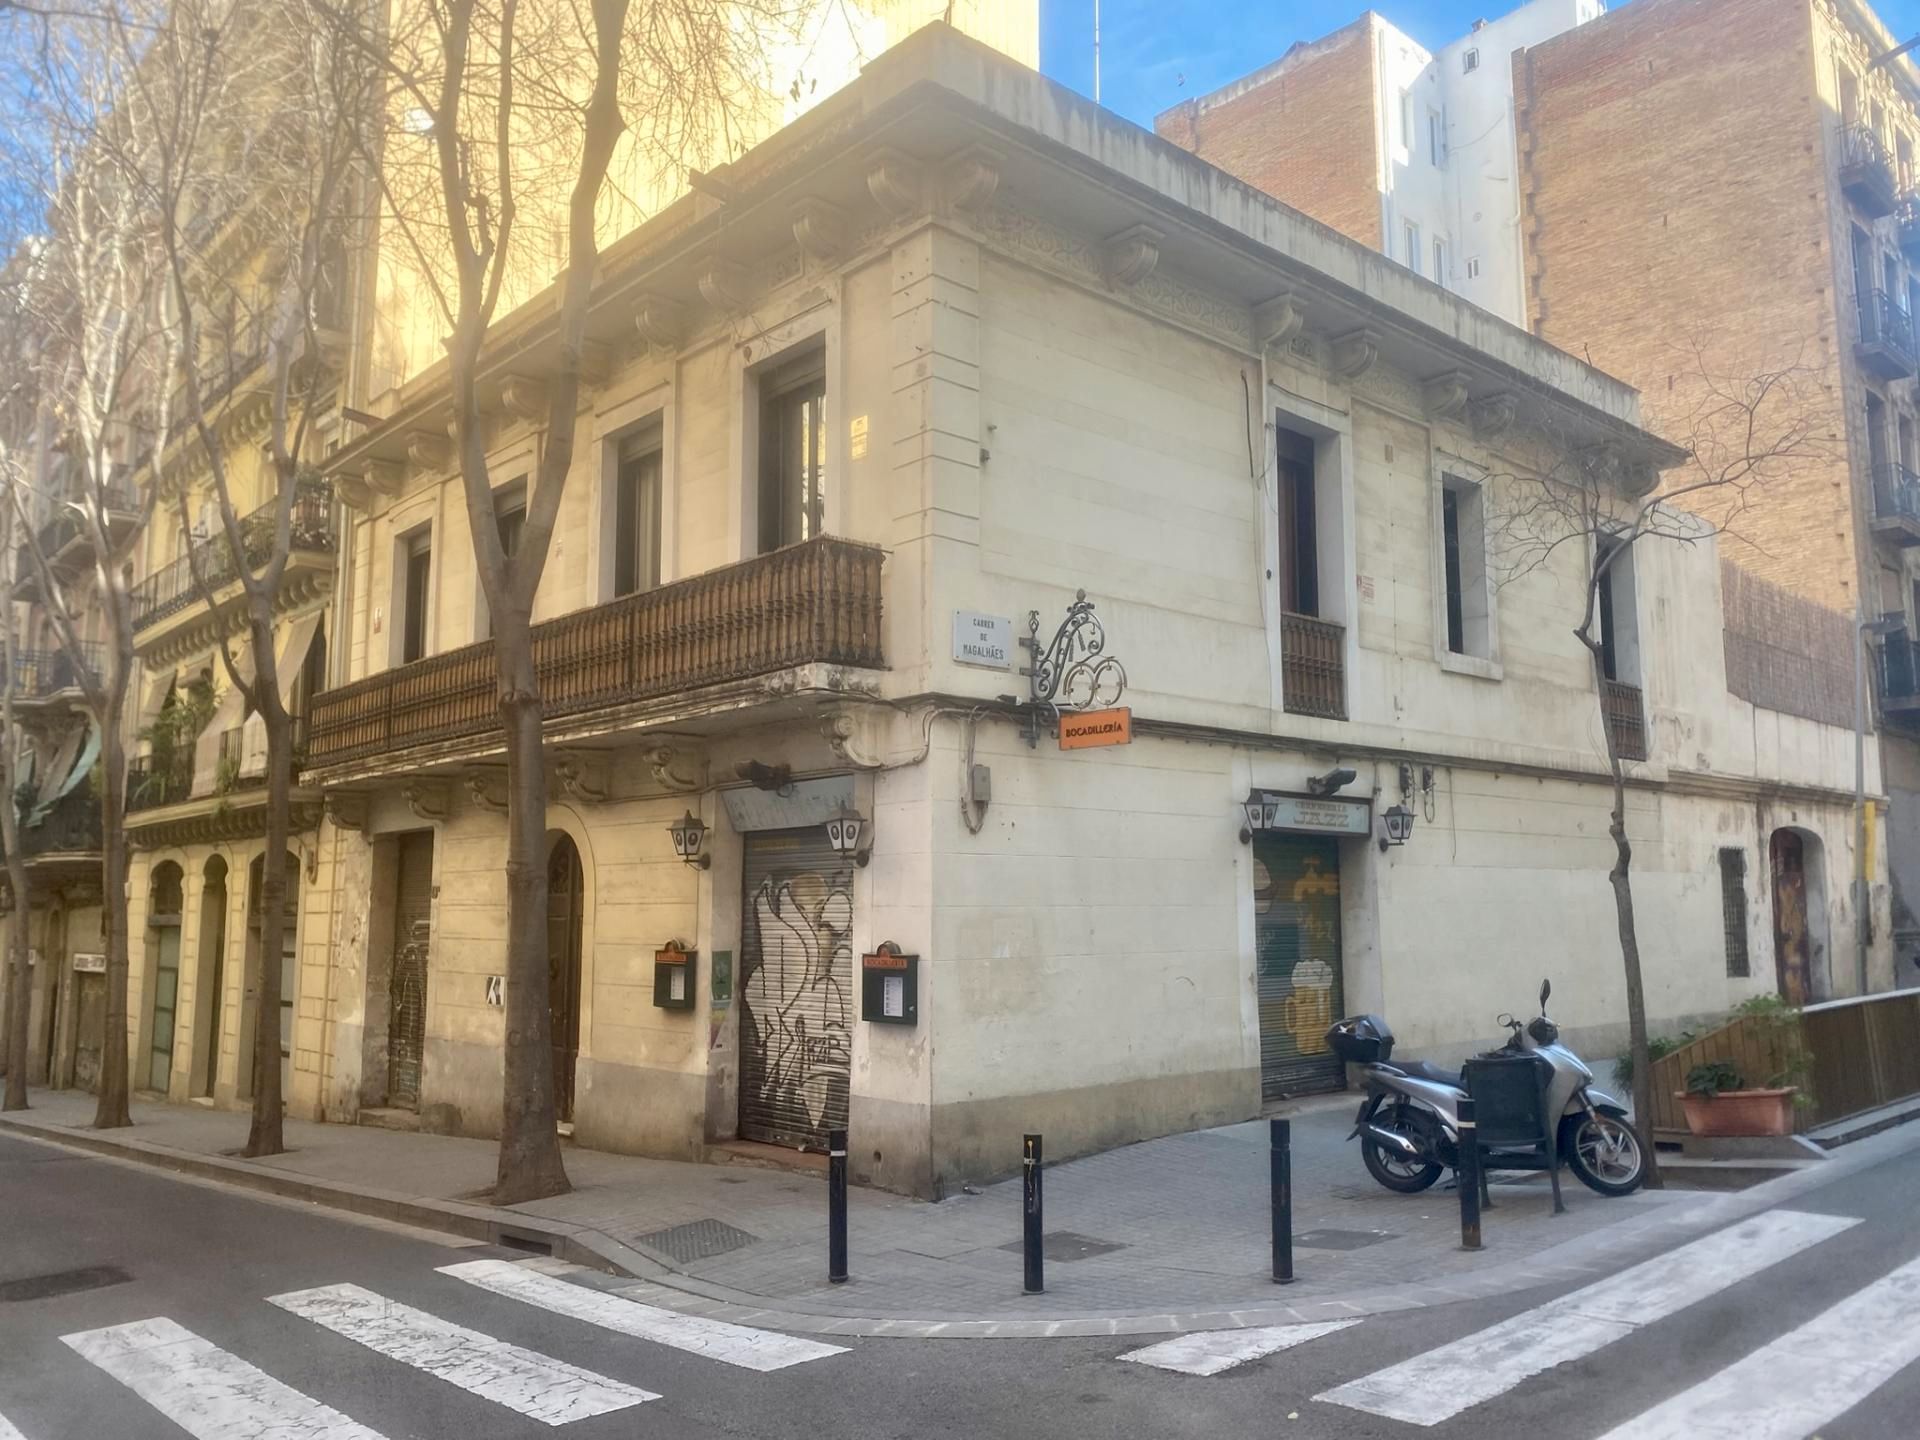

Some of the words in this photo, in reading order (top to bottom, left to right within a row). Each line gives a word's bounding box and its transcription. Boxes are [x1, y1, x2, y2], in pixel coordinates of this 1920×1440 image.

[973, 618, 994, 629] CARRER
[980, 633, 988, 641] DE
[963, 645, 1004, 660] MAGALHÃES
[1066, 721, 1123, 737] BOCADILLERÍA
[1294, 812, 1349, 827] JAZZ
